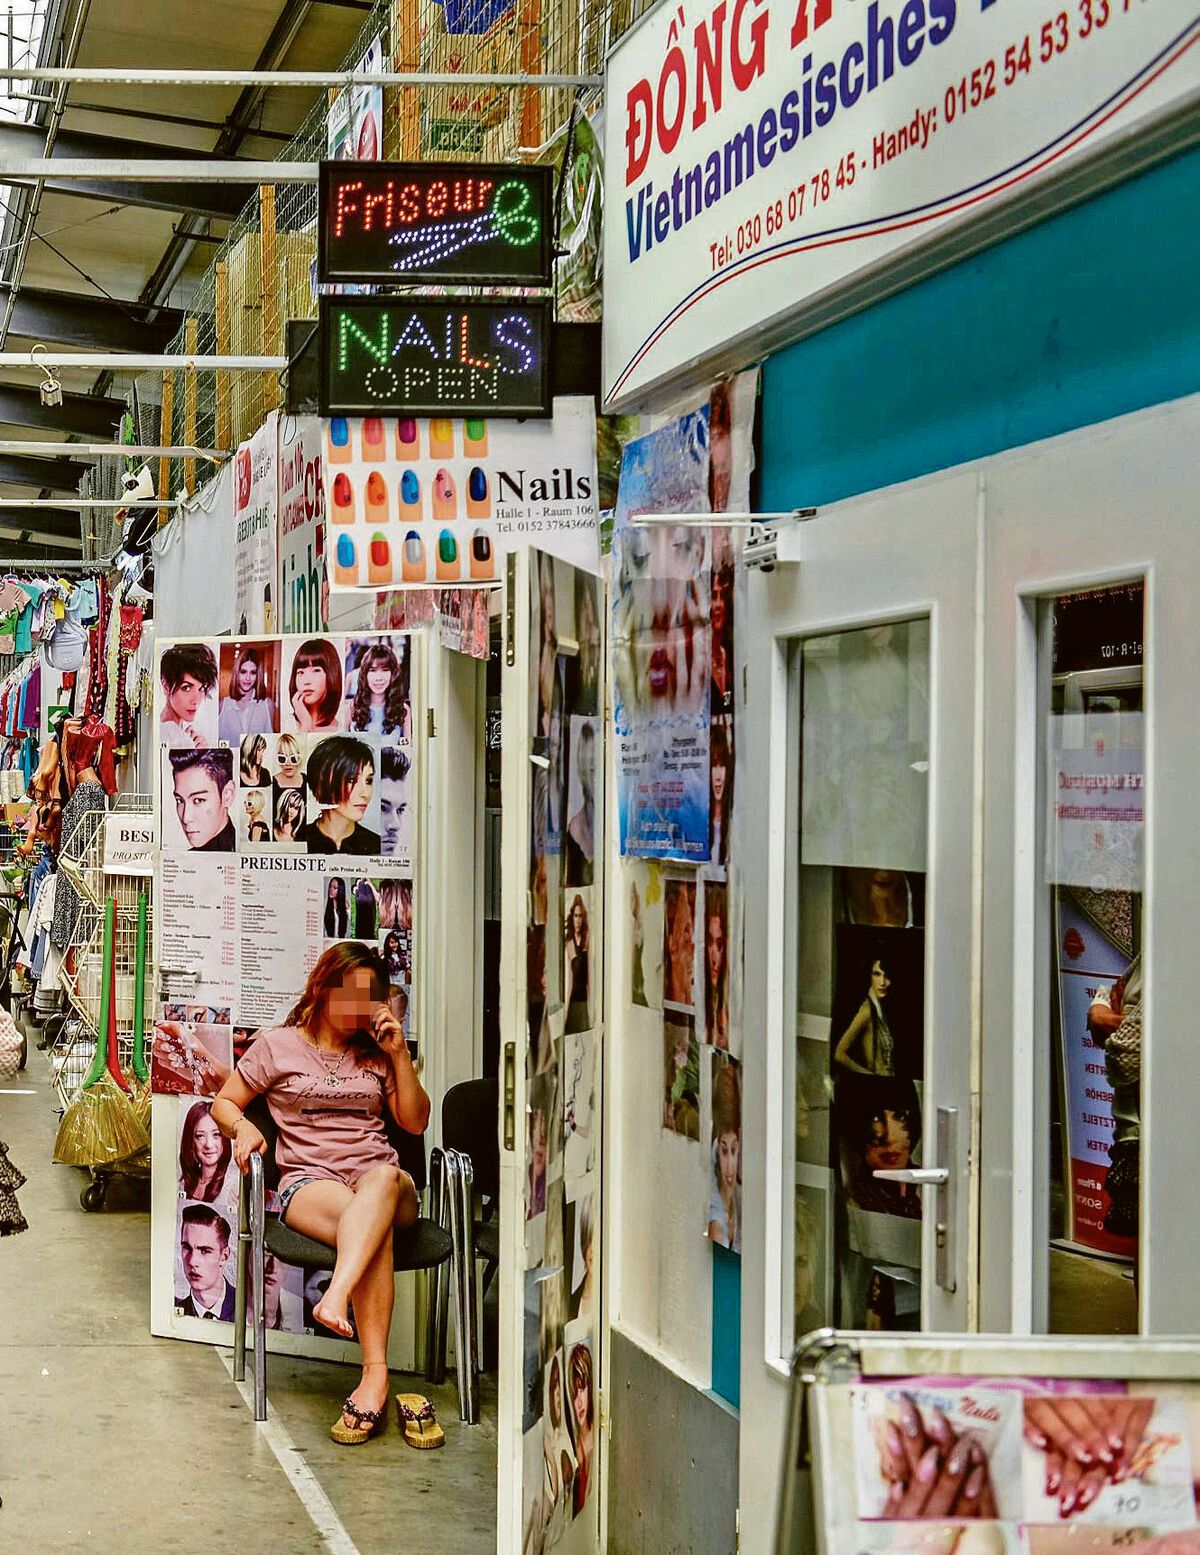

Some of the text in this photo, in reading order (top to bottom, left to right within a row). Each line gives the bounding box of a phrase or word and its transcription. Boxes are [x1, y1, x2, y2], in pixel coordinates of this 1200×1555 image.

[625, 0, 957, 263] Vietnamesisches
[709, 242, 733, 271] Tel:
[736, 215, 761, 254] 030
[766, 200, 783, 236] 68
[788, 184, 806, 222] 07
[811, 169, 829, 207] 78
[835, 152, 855, 190] 45
[873, 107, 937, 170] Handy:
[944, 60, 996, 123] 0152
[1004, 31, 1031, 86] 54
[1040, 12, 1068, 64] 53
[334, 178, 494, 238] Friseur
[338, 313, 532, 374] NAILS
[365, 366, 498, 400] OPEN
[496, 468, 592, 503] Nails
[496, 508, 522, 519] Halle
[543, 505, 572, 517] Raum
[575, 504, 595, 515] 106
[496, 518, 596, 533] Tel. 0152 37843666
[120, 829, 153, 842] BES
[112, 852, 133, 861] PRO
[240, 857, 326, 873] PREISLISTE
